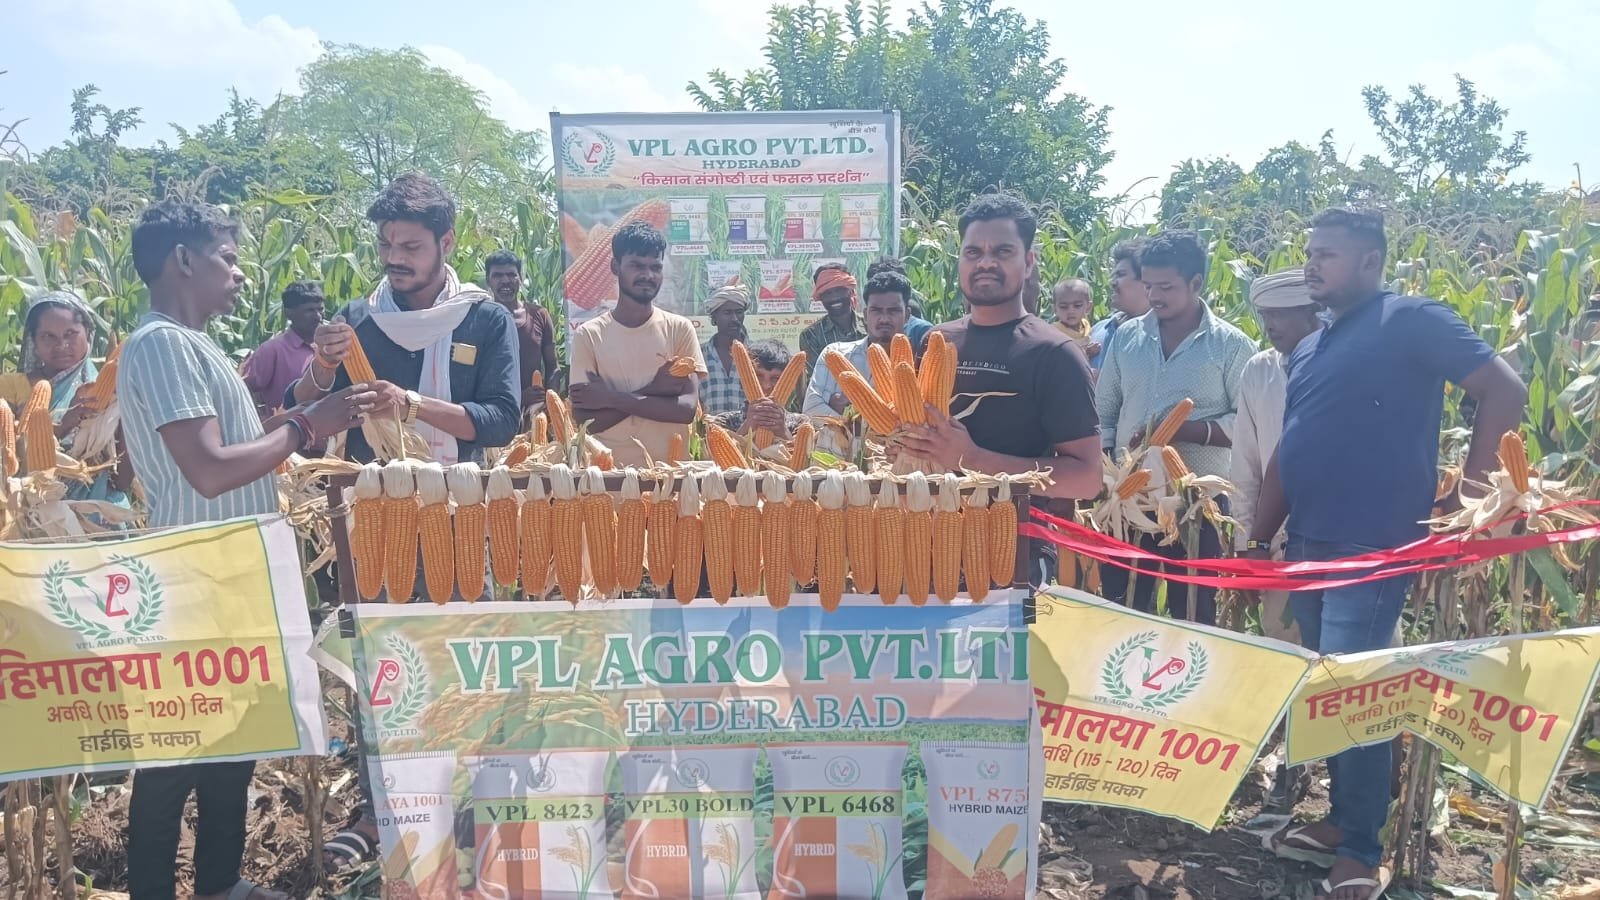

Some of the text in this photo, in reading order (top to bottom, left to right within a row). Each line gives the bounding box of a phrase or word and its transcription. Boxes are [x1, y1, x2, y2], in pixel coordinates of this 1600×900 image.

[627, 136, 874, 156] VPL AGRO PVT.LTD.
[702, 159, 801, 170] HYDERABAD
[746, 172, 768, 185] एवं
[773, 173, 813, 184] फसल
[97, 637, 124, 648] AGRO
[173, 645, 271, 688] 1001
[447, 637, 579, 691] VPL
[594, 633, 782, 687] AGRO
[47, 699, 92, 724] अवधि
[97, 703, 129, 724] (115
[149, 697, 186, 721] 120)
[190, 692, 224, 717] दिन
[1110, 698, 1134, 709] AGRO
[1305, 667, 1559, 742] हिमालया 1001
[626, 695, 906, 734] HYDERABAD
[1431, 700, 1465, 727] 120)
[1468, 718, 1496, 746] दिन
[1033, 687, 1241, 772] मालया 1001
[1423, 719, 1466, 751] मक्का
[78, 729, 202, 753] हाईब्रिड मक्का
[1043, 743, 1073, 764] वधि
[1074, 748, 1101, 768] (115
[1116, 757, 1150, 779] 120)
[1150, 761, 1182, 783] दिन
[940, 786, 981, 801] VPL
[1044, 772, 1148, 799] हाईब्रिड मक्का
[413, 795, 443, 808] 1001
[696, 796, 753, 813] BOLD
[783, 795, 895, 813] VPL 6468
[949, 804, 992, 814] HYBRID
[394, 813, 431, 825] MAIZE
[486, 803, 594, 821] VPL 8423
[497, 847, 538, 861] HYBRID
[646, 844, 687, 858] HYBRID
[794, 843, 835, 857] HYBRID
